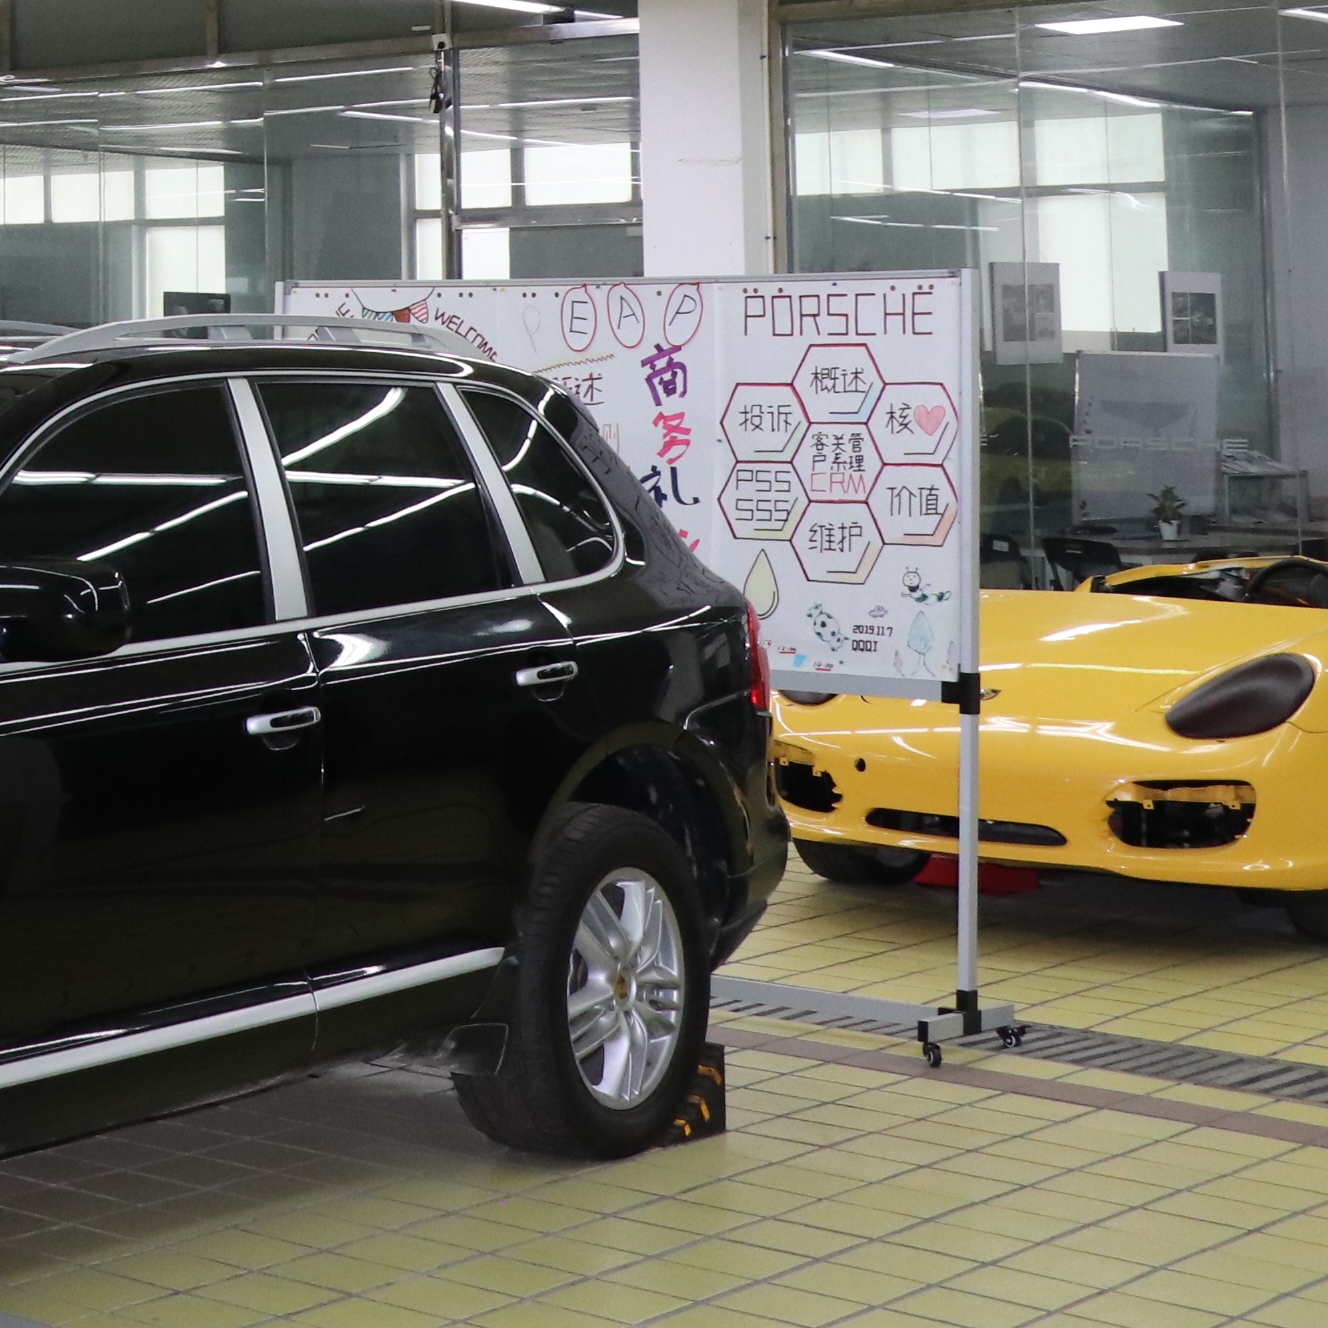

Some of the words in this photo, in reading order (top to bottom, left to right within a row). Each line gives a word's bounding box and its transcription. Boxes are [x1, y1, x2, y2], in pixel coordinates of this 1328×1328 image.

[744, 291, 934, 337] PORSCHE
[810, 366, 867, 395] 概述
[739, 403, 793, 433] 投诉
[885, 402, 915, 435] 核
[736, 469, 792, 493] PSS
[811, 472, 867, 494] CRM
[735, 498, 790, 522] SSS
[886, 484, 943, 517] 价值
[809, 522, 862, 553] 维护
